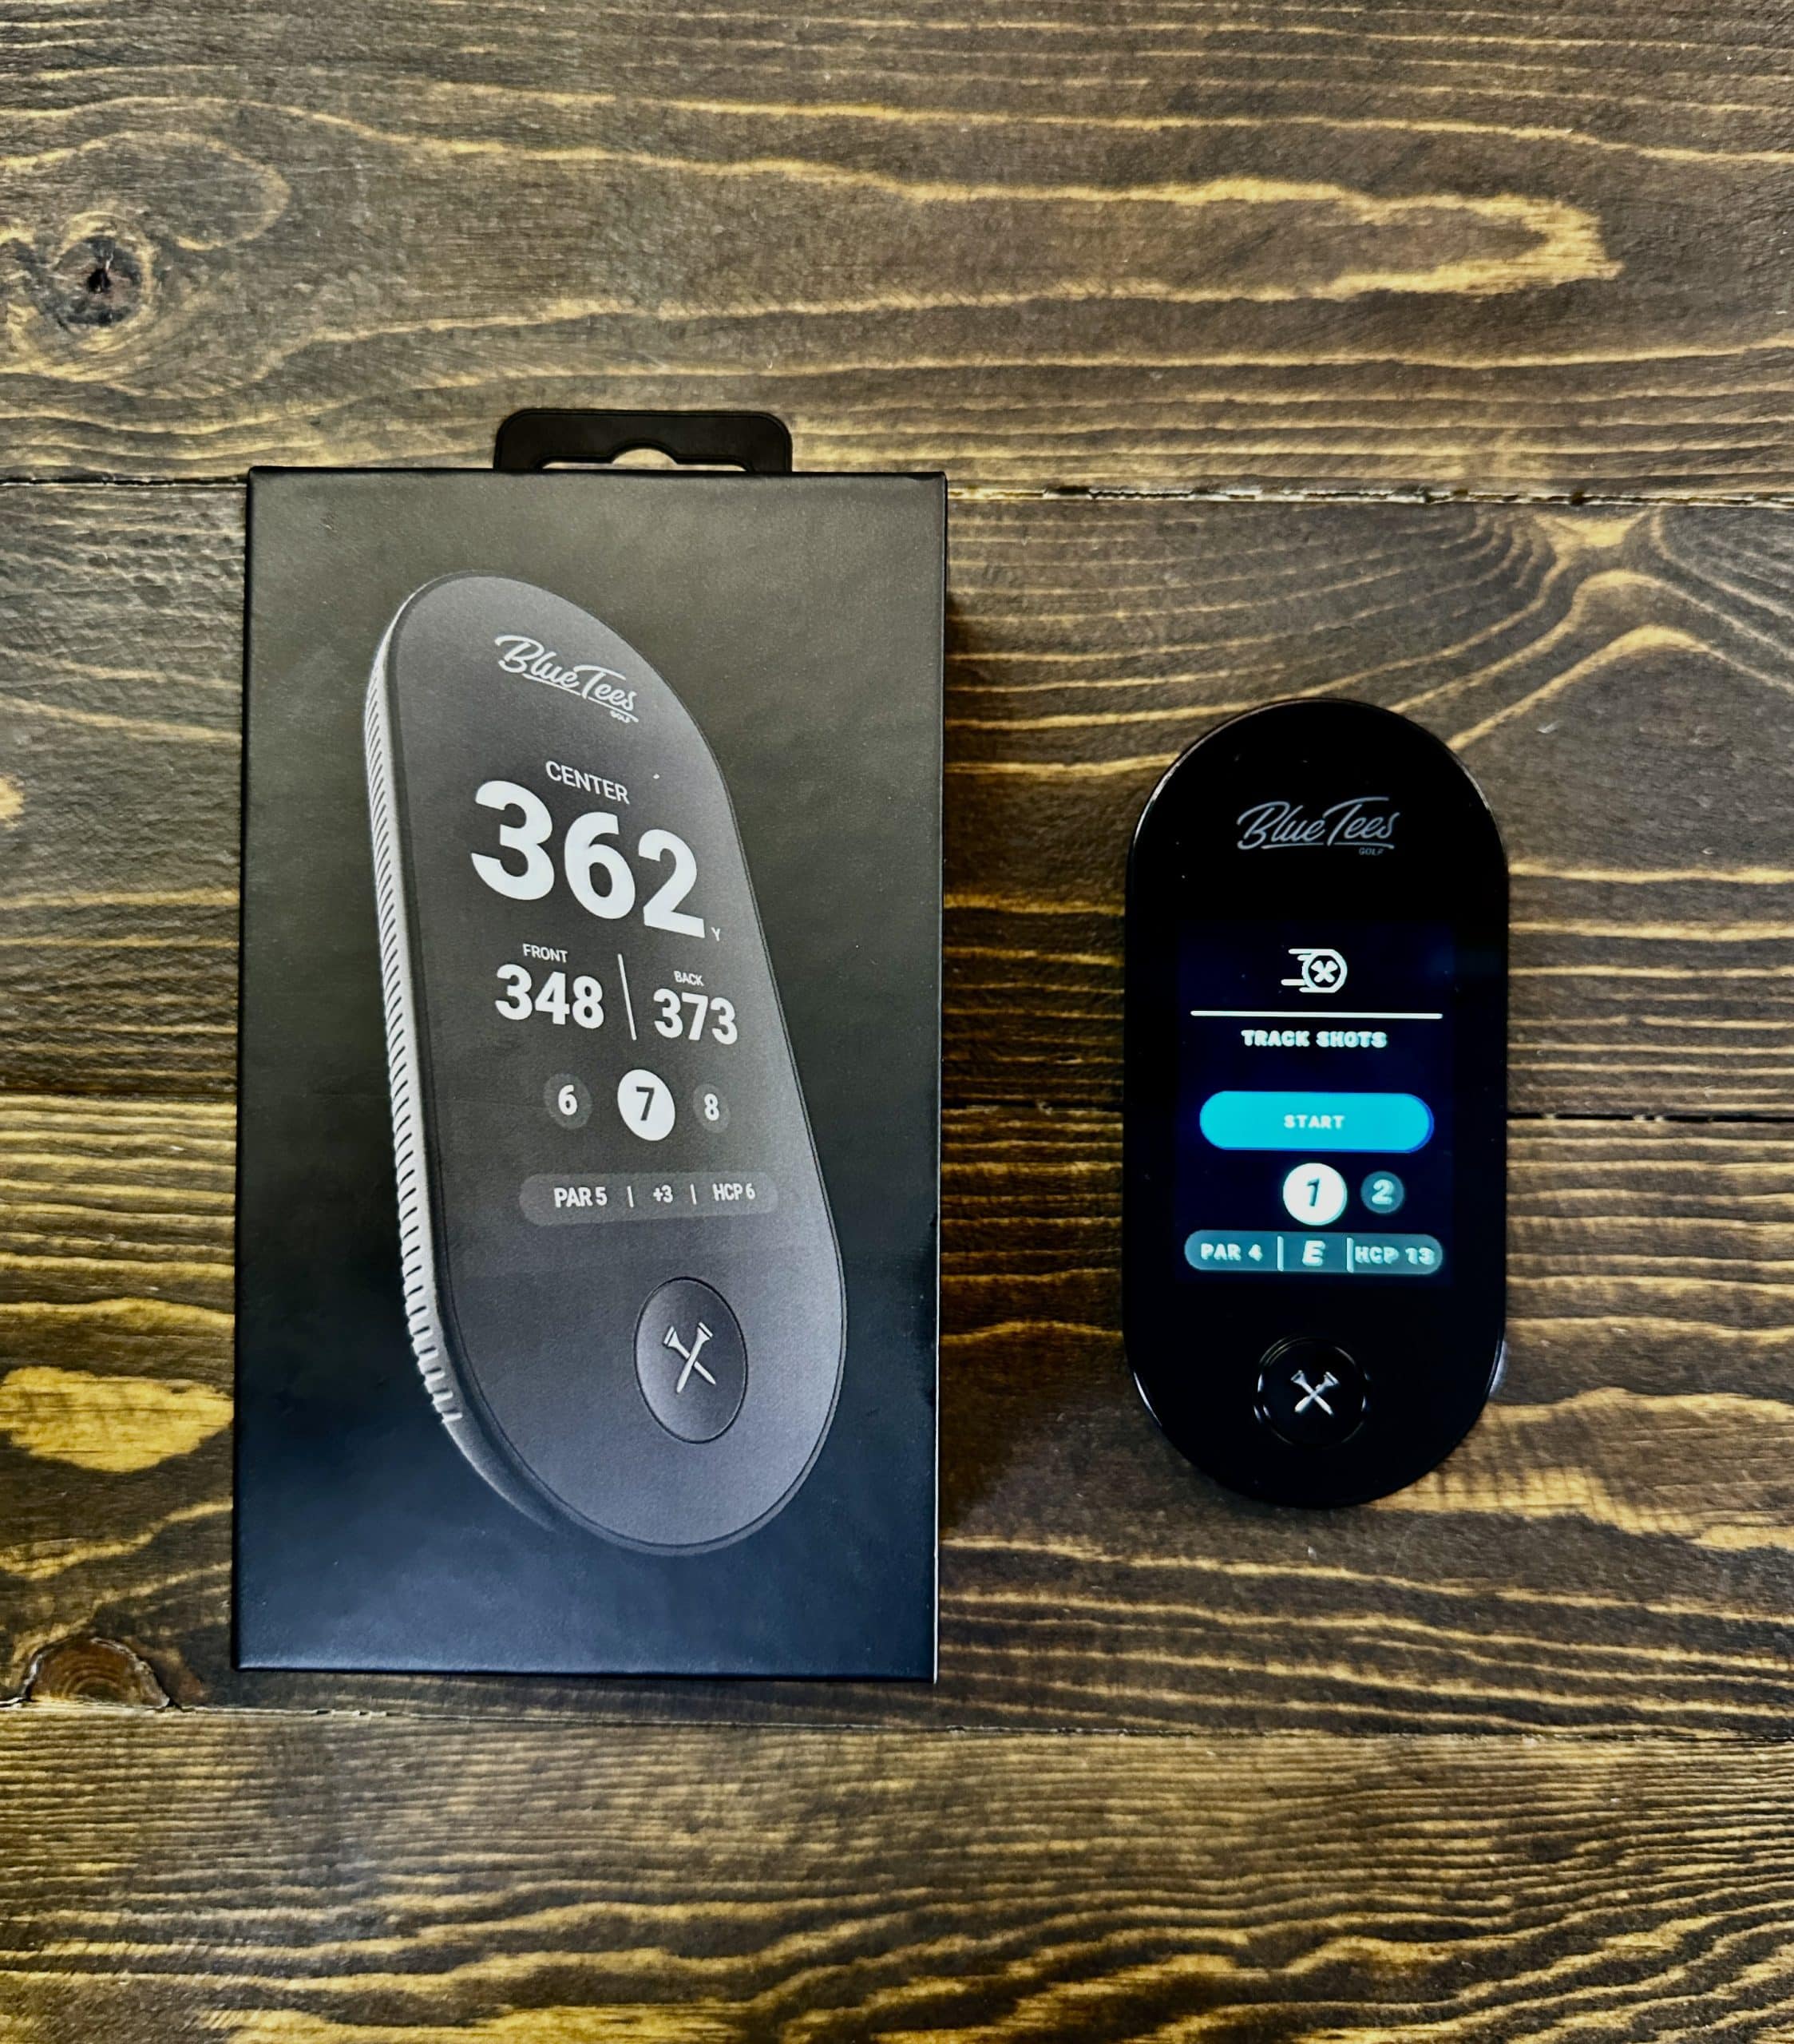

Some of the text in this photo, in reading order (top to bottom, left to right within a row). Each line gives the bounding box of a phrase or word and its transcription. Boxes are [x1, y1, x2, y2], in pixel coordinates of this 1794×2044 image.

[494, 635, 638, 712] Blue Tees
[545, 760, 631, 805] CENTER
[1237, 797, 1400, 850] Blue Tees
[470, 779, 720, 942] 362 Y
[1359, 847, 1384, 856] GOLF
[522, 943, 568, 964] FRONT
[674, 970, 705, 988] BACK
[494, 963, 605, 1029] 348
[652, 988, 738, 1045] 373
[1241, 1030, 1387, 1048] TRACK SHOTS
[558, 1084, 578, 1115] 6
[636, 1086, 655, 1121] 7
[704, 1093, 719, 1121] 8
[1284, 1115, 1345, 1129] START
[553, 1186, 608, 1207] PAR 5
[653, 1185, 673, 1202] +3
[712, 1183, 756, 1201] HCP 6
[1306, 1178, 1321, 1207] 1
[1371, 1179, 1394, 1205] 2
[1201, 1243, 1263, 1262] PAR 4
[1301, 1240, 1326, 1266] E
[1355, 1246, 1436, 1265] HCP 13
